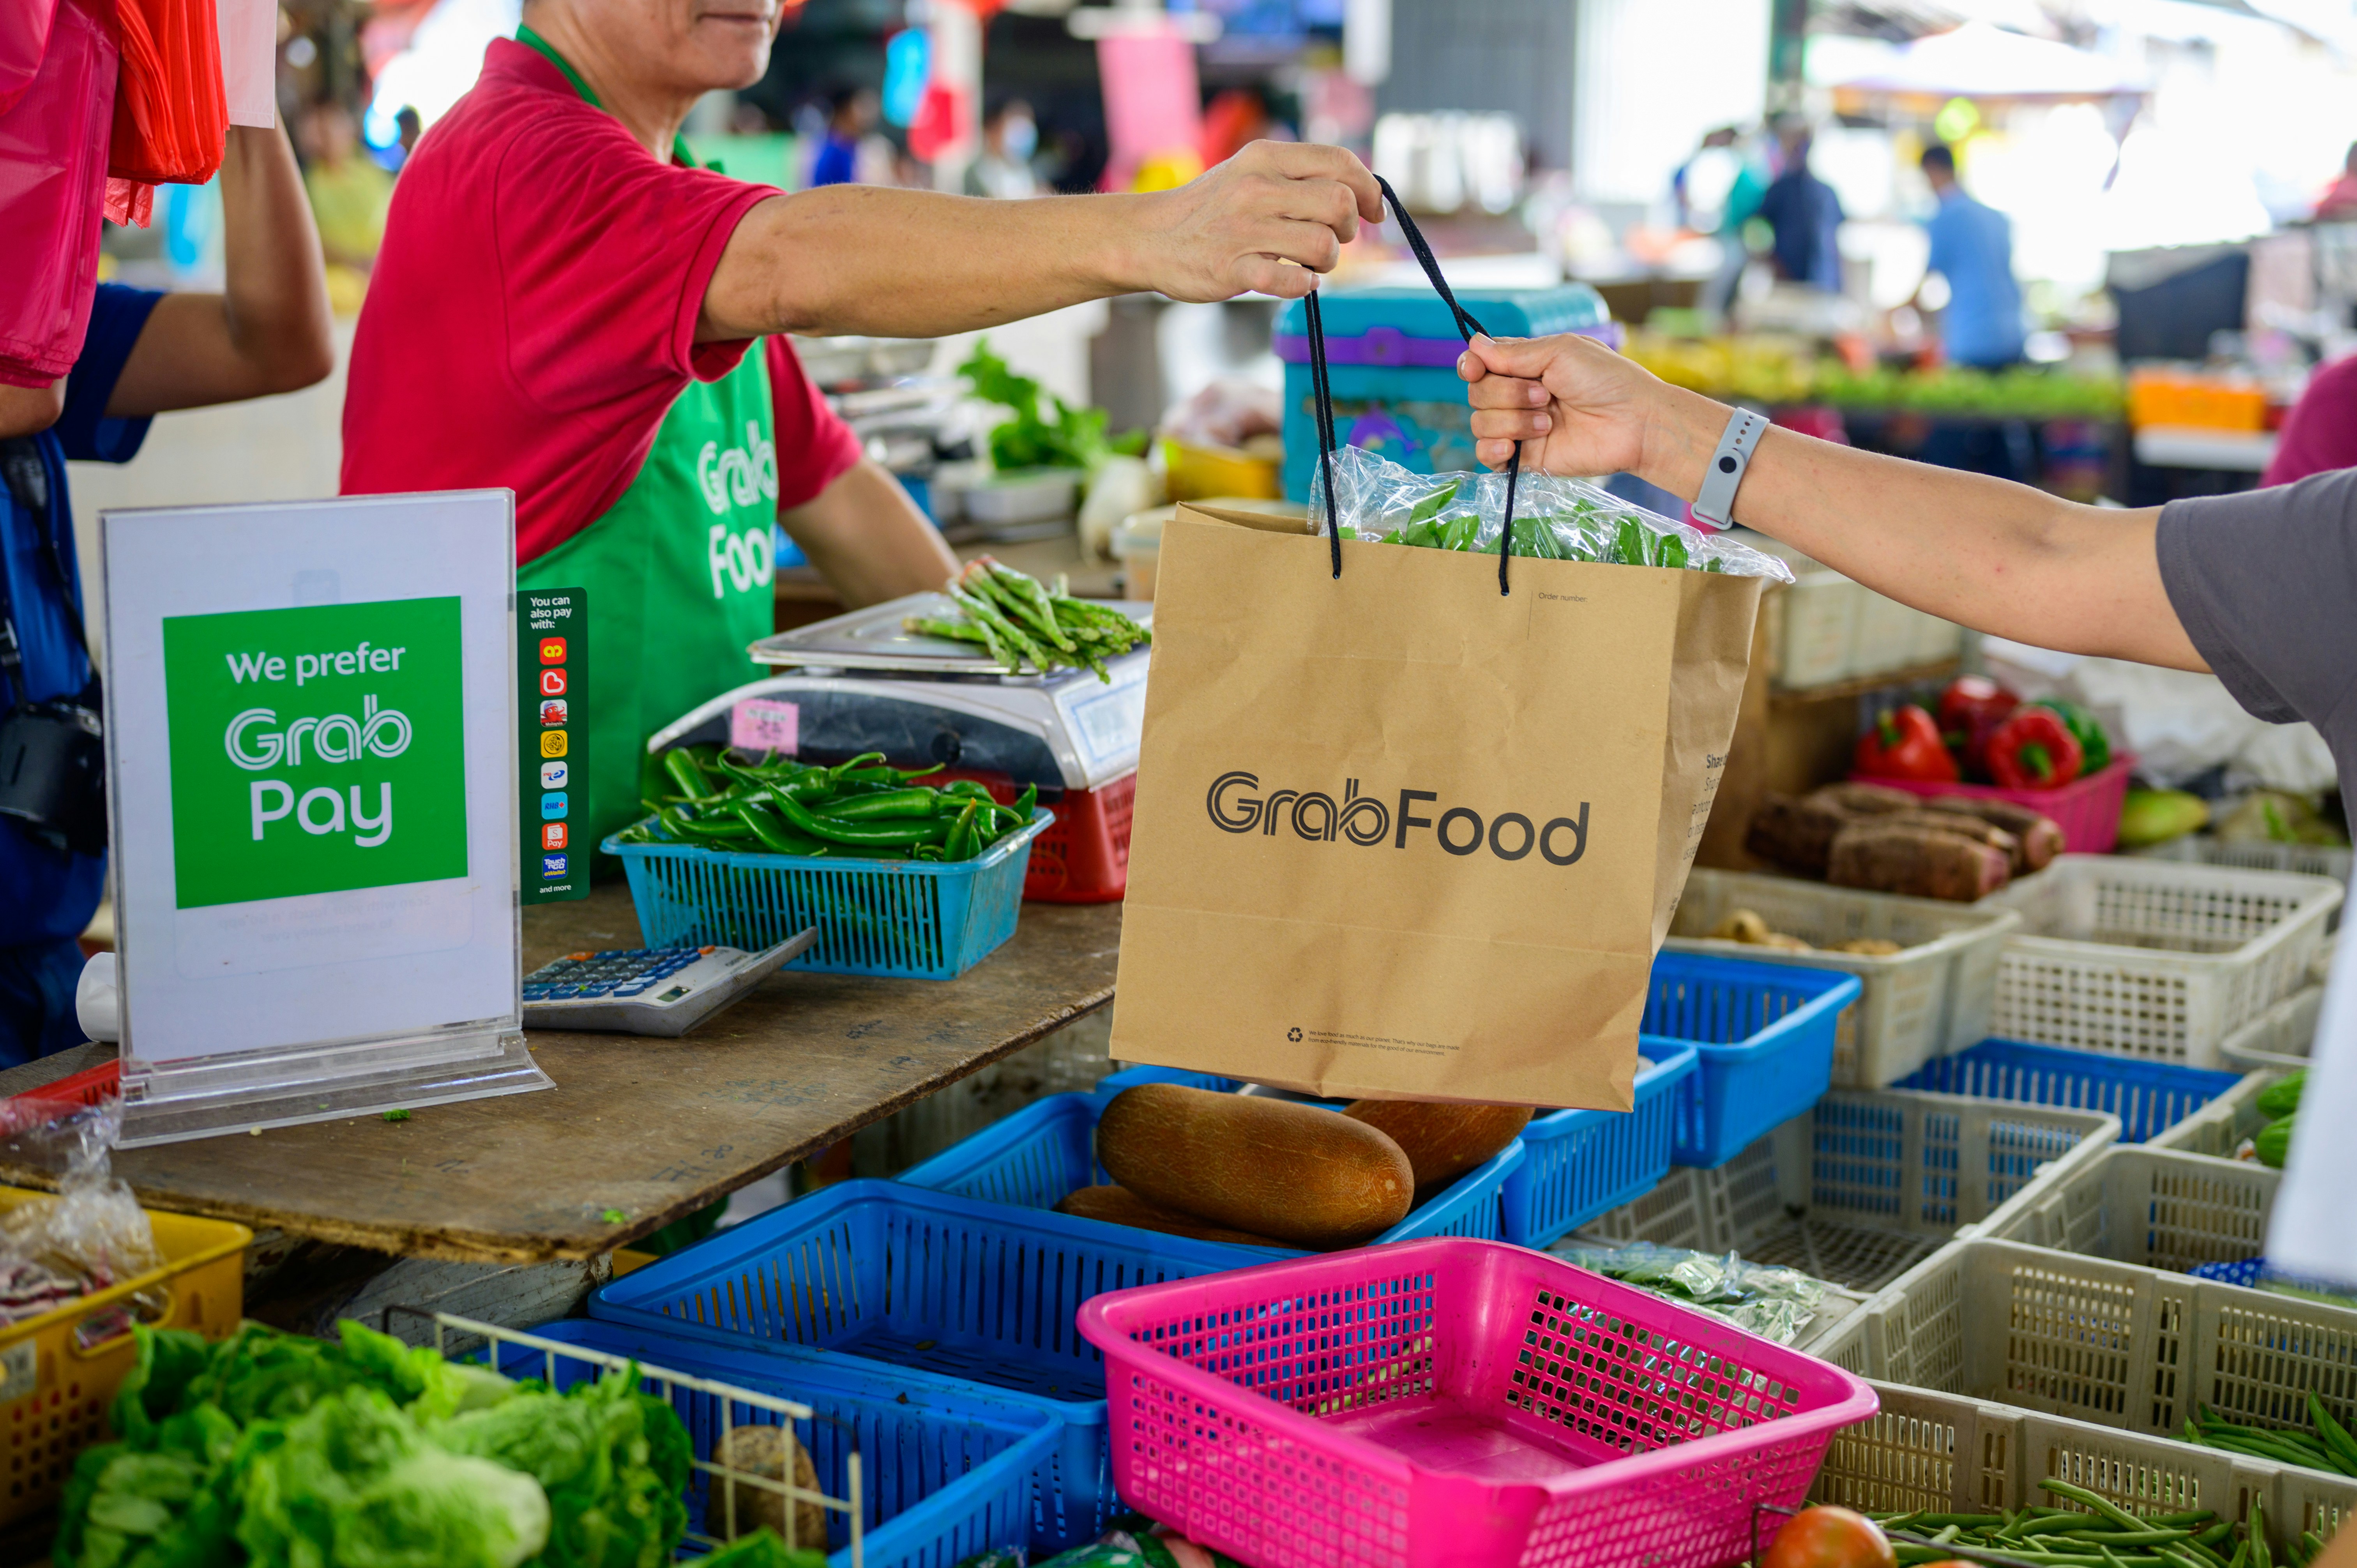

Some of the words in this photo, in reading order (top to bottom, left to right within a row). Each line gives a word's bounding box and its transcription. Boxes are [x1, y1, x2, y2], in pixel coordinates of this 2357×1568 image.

[697, 419, 779, 515] Grab
[709, 523, 777, 599] Foo
[1539, 592, 1558, 600] Order
[530, 597, 550, 607] You
[551, 597, 570, 606] can
[530, 608, 551, 618] also
[553, 608, 572, 619] pay
[530, 619, 555, 630] with:
[226, 652, 286, 683] We
[296, 642, 405, 686] prefer
[225, 694, 412, 771] Grab
[544, 802, 559, 810] RHB
[251, 780, 392, 847] Pay
[1206, 771, 1590, 866] GrabFood
[547, 840, 563, 848] Pay
[544, 857, 565, 865] Touch
